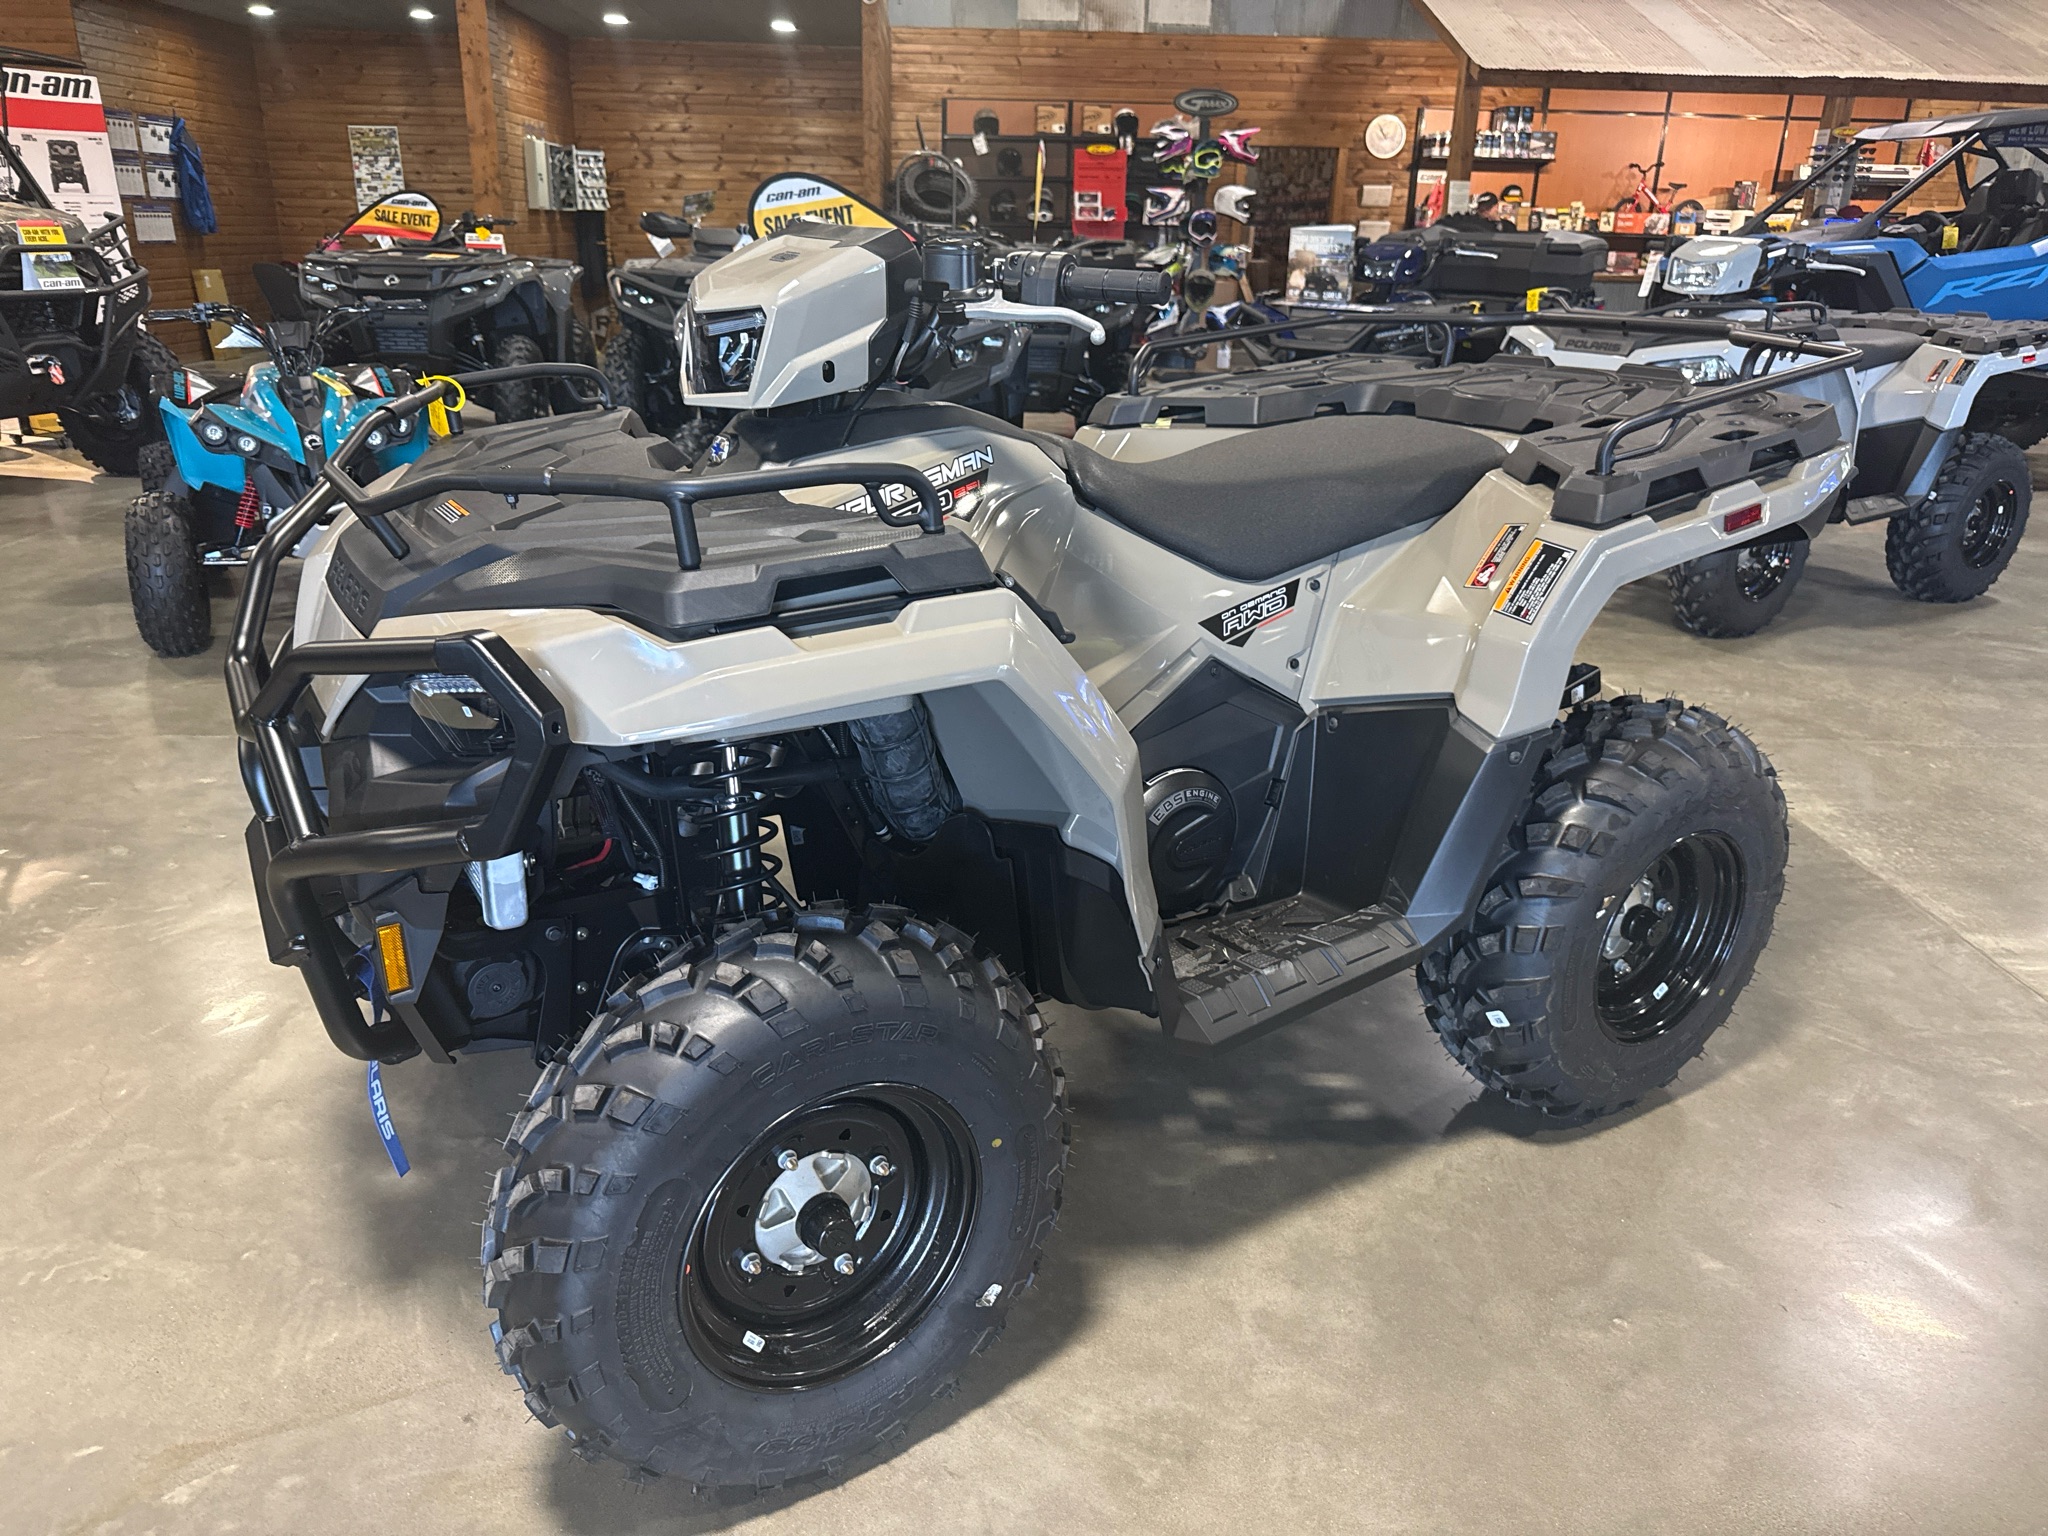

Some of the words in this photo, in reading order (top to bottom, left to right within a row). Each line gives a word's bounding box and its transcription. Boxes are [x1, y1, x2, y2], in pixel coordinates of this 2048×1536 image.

[391, 198, 428, 207] can-am
[766, 186, 821, 203] can-am
[374, 208, 399, 225] SALE
[401, 210, 432, 227] EVENT
[763, 214, 801, 236] SA
[43, 279, 80, 288] can-am
[1564, 339, 1621, 352] POLARIS
[1509, 556, 1531, 587] WARNING
[1223, 594, 1288, 637] AWD
[1152, 793, 1183, 821] EBS
[1186, 790, 1220, 803] ENGINE
[751, 1020, 939, 1090] CARLSTAR
[371, 1060, 395, 1140] LARIS
